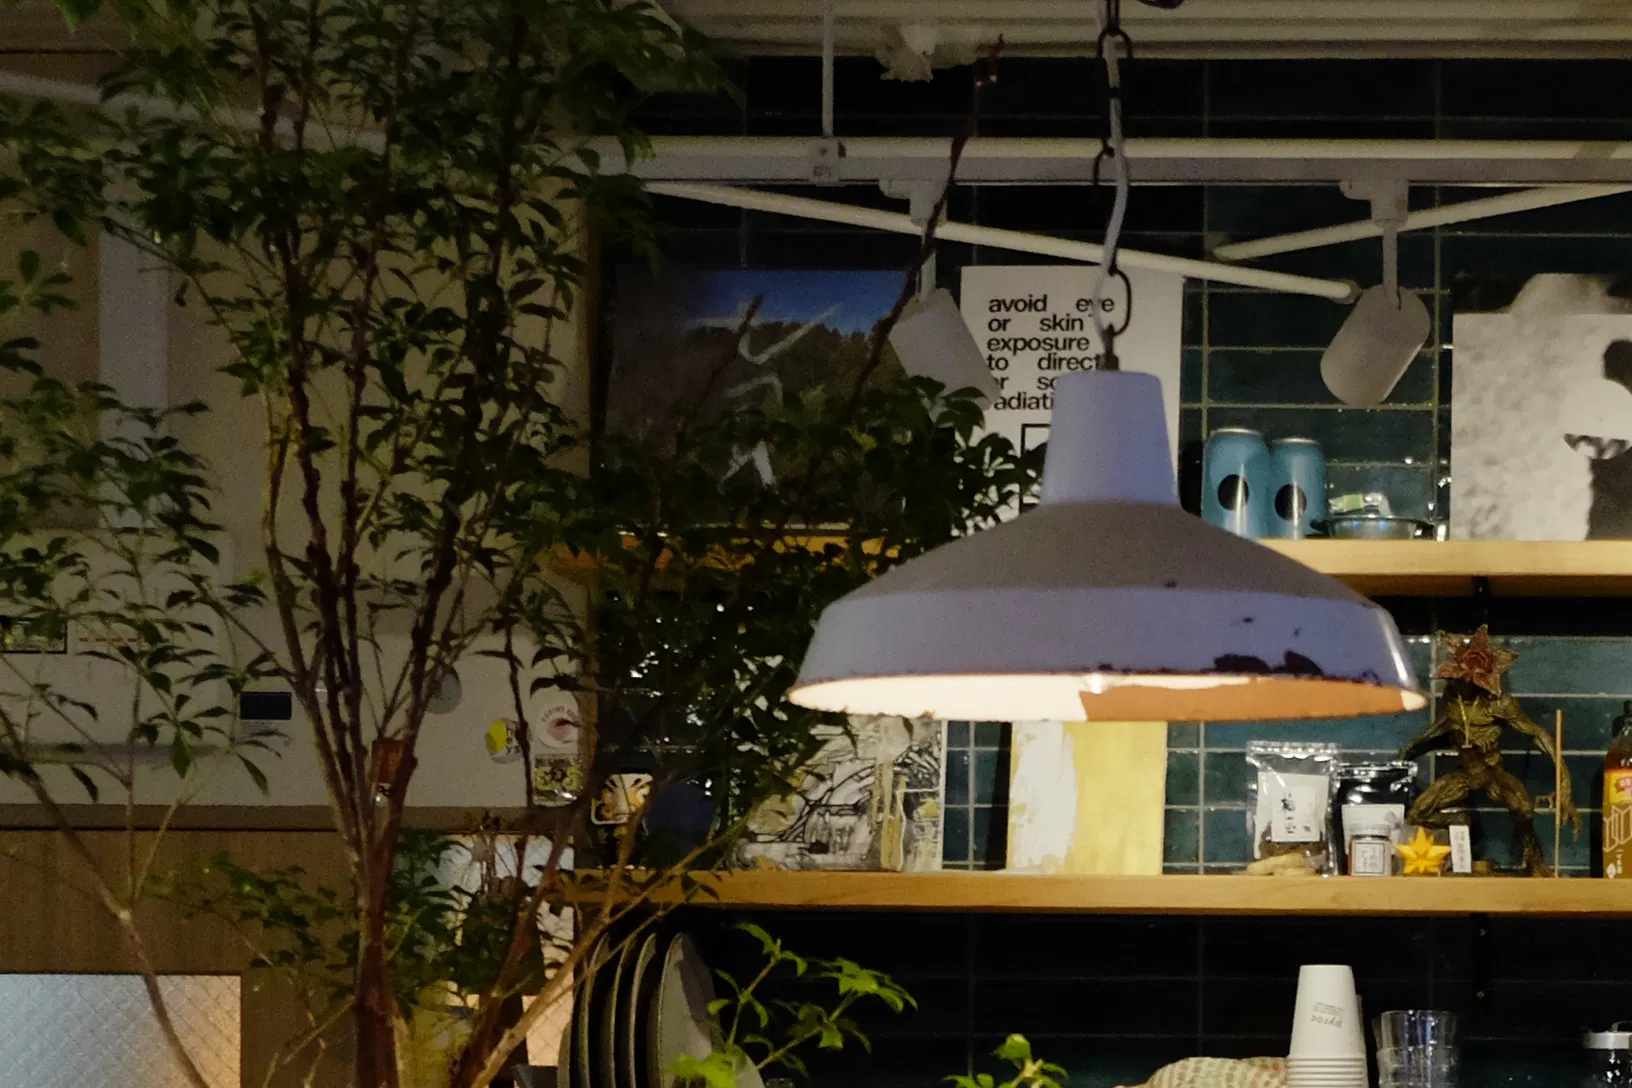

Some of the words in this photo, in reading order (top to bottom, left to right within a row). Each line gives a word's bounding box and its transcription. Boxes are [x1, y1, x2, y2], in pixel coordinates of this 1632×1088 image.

[988, 294, 1047, 313] avoid
[988, 318, 1012, 332] or
[1039, 314, 1084, 332] skin
[987, 337, 1090, 356] exposure
[987, 354, 1009, 371] to
[1037, 353, 1102, 371] direct
